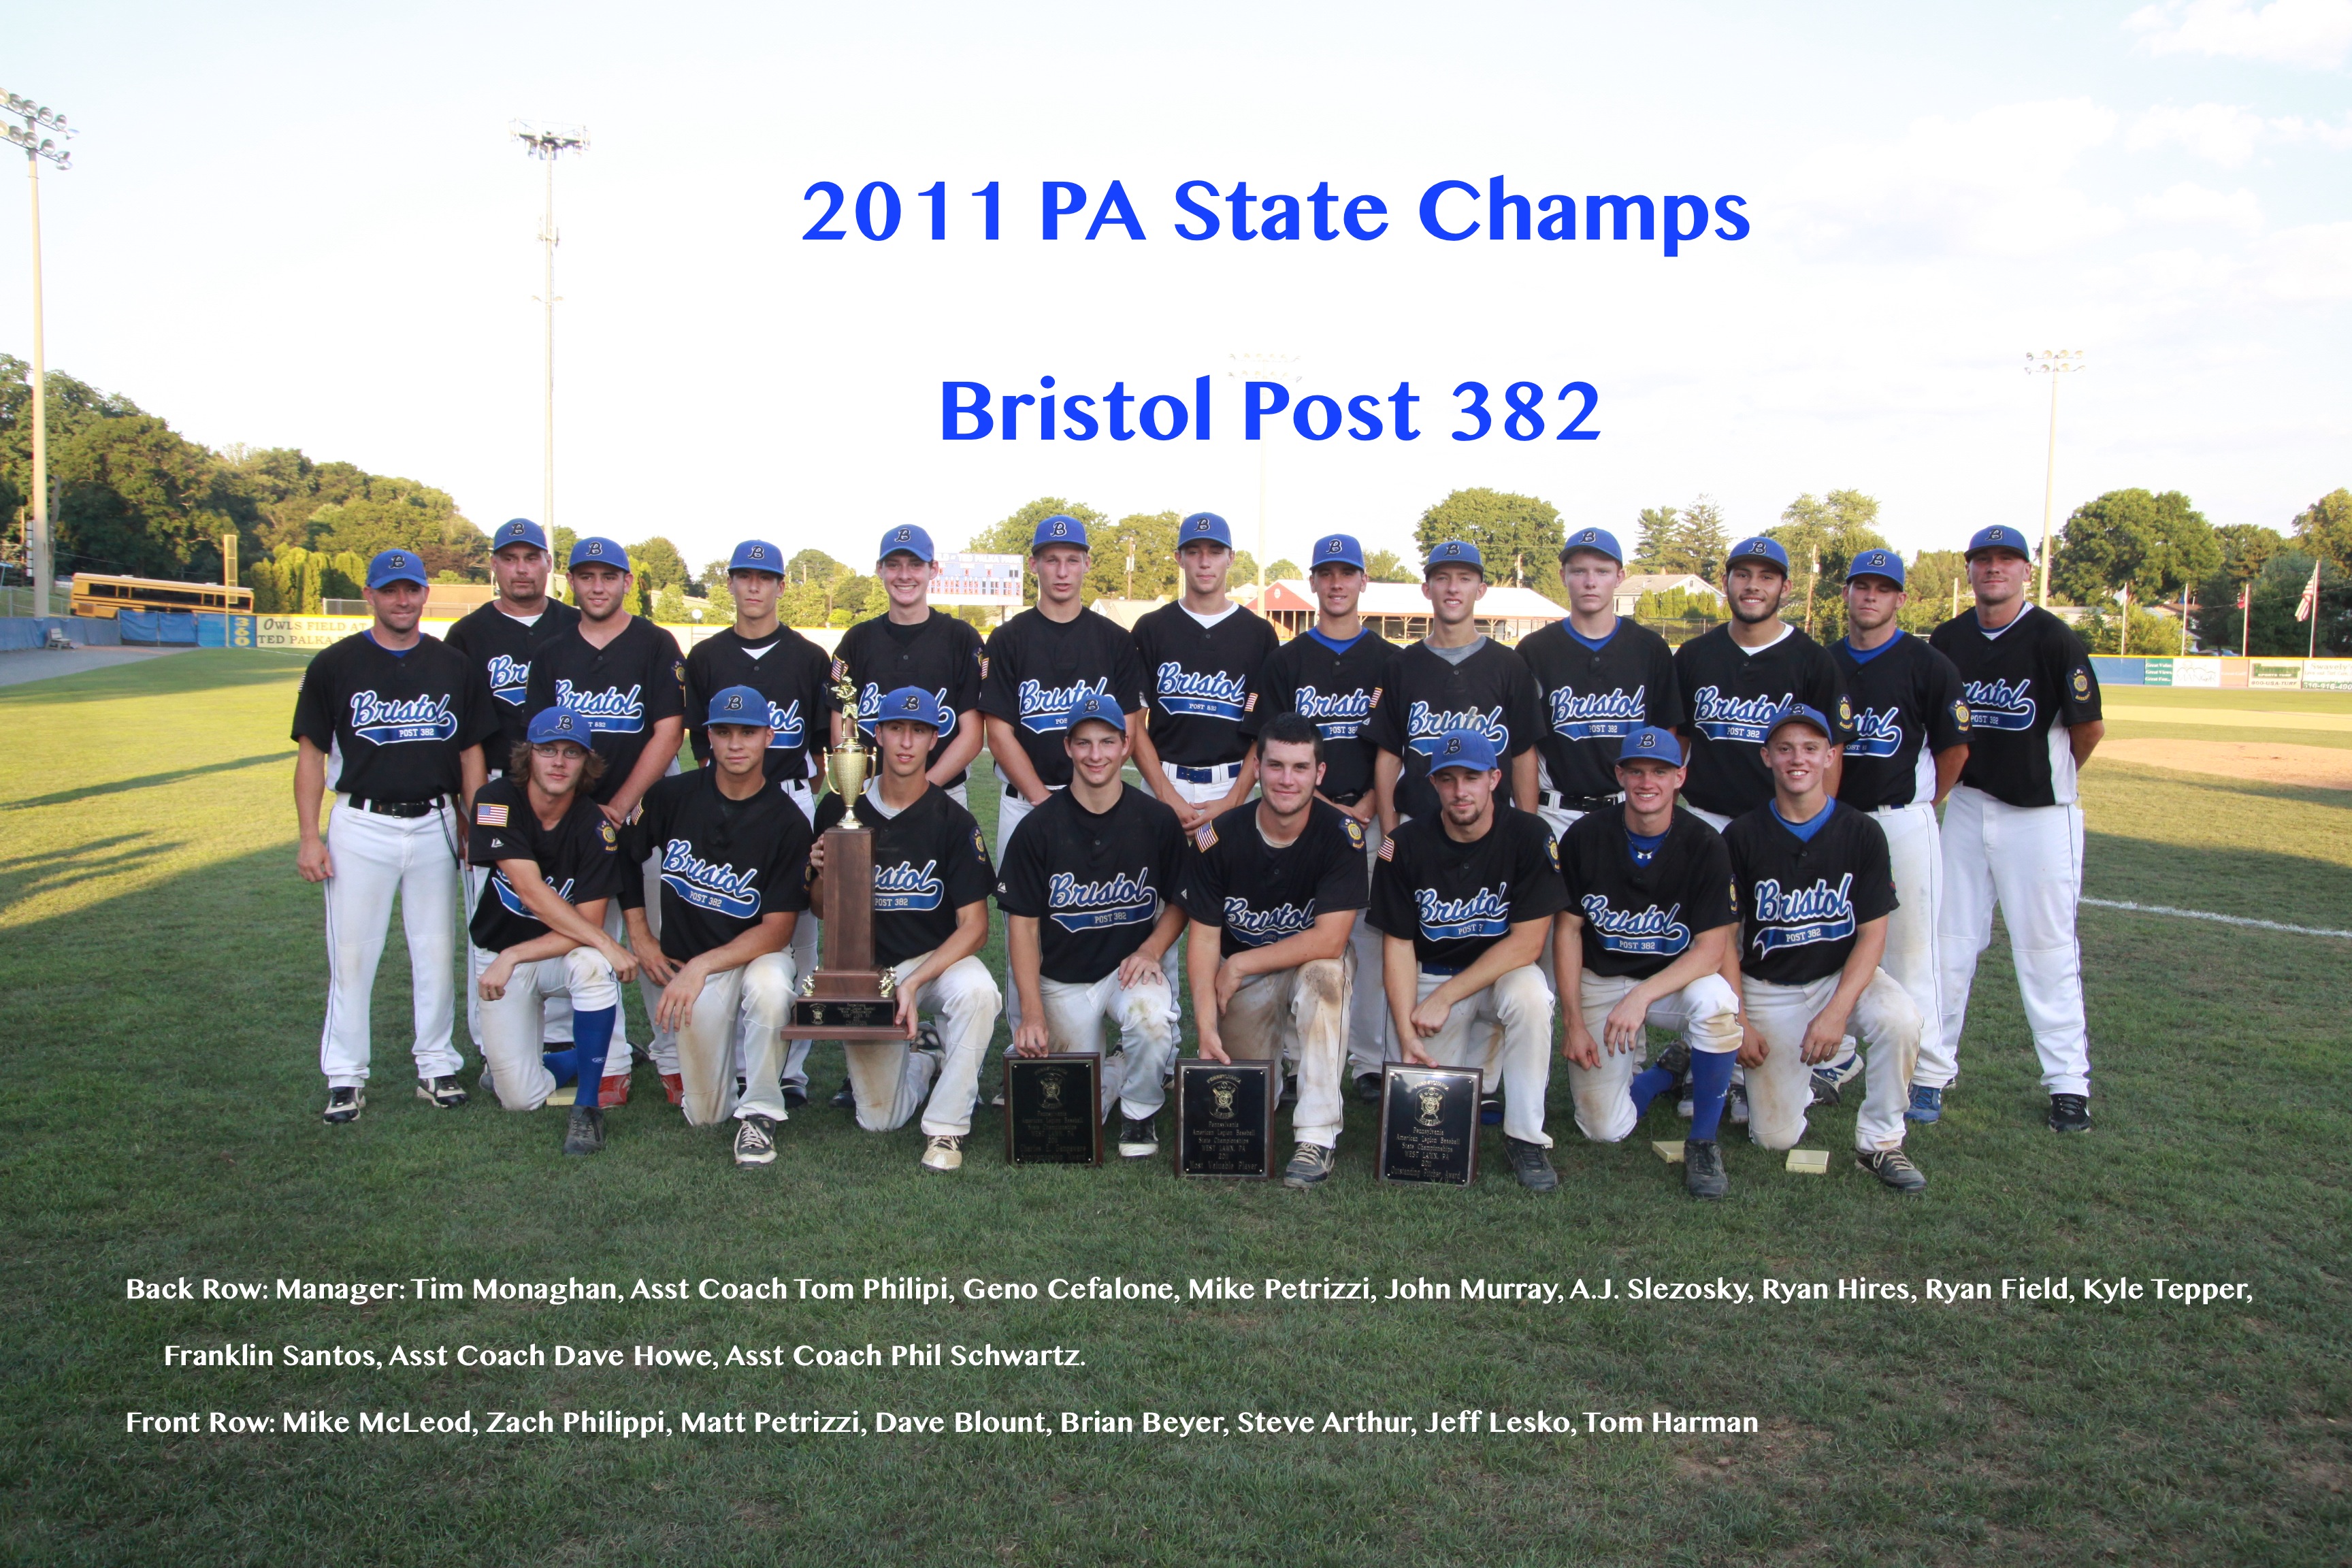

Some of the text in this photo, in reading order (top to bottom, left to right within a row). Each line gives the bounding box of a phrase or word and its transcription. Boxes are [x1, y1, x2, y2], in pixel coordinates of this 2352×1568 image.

[263, 618, 368, 632] OWLS FIELD AT
[257, 635, 284, 644] TED
[290, 636, 333, 644] PALKA
[1157, 662, 1245, 702] Bristol
[350, 689, 451, 728] Bristol
[1295, 686, 1371, 719] Bristo
[1549, 685, 1645, 724] Bristol
[399, 728, 434, 737] POST 382
[1329, 725, 1345, 735] POST
[1589, 725, 1617, 733] POST 382
[1727, 727, 1760, 738] POST 382
[663, 838, 757, 898] Bristol
[1049, 867, 1148, 908] Bristol
[690, 891, 722, 907] POST 382
[894, 898, 908, 906] 382
[1415, 882, 1511, 922] Bristol
[1754, 872, 1853, 923] Bristol
[1094, 912, 1127, 924] POST 382
[1581, 894, 1680, 935] Bristol
[1458, 924, 1476, 934] POST
[1786, 928, 1821, 943] POST 382
[1619, 941, 1639, 949] POST
